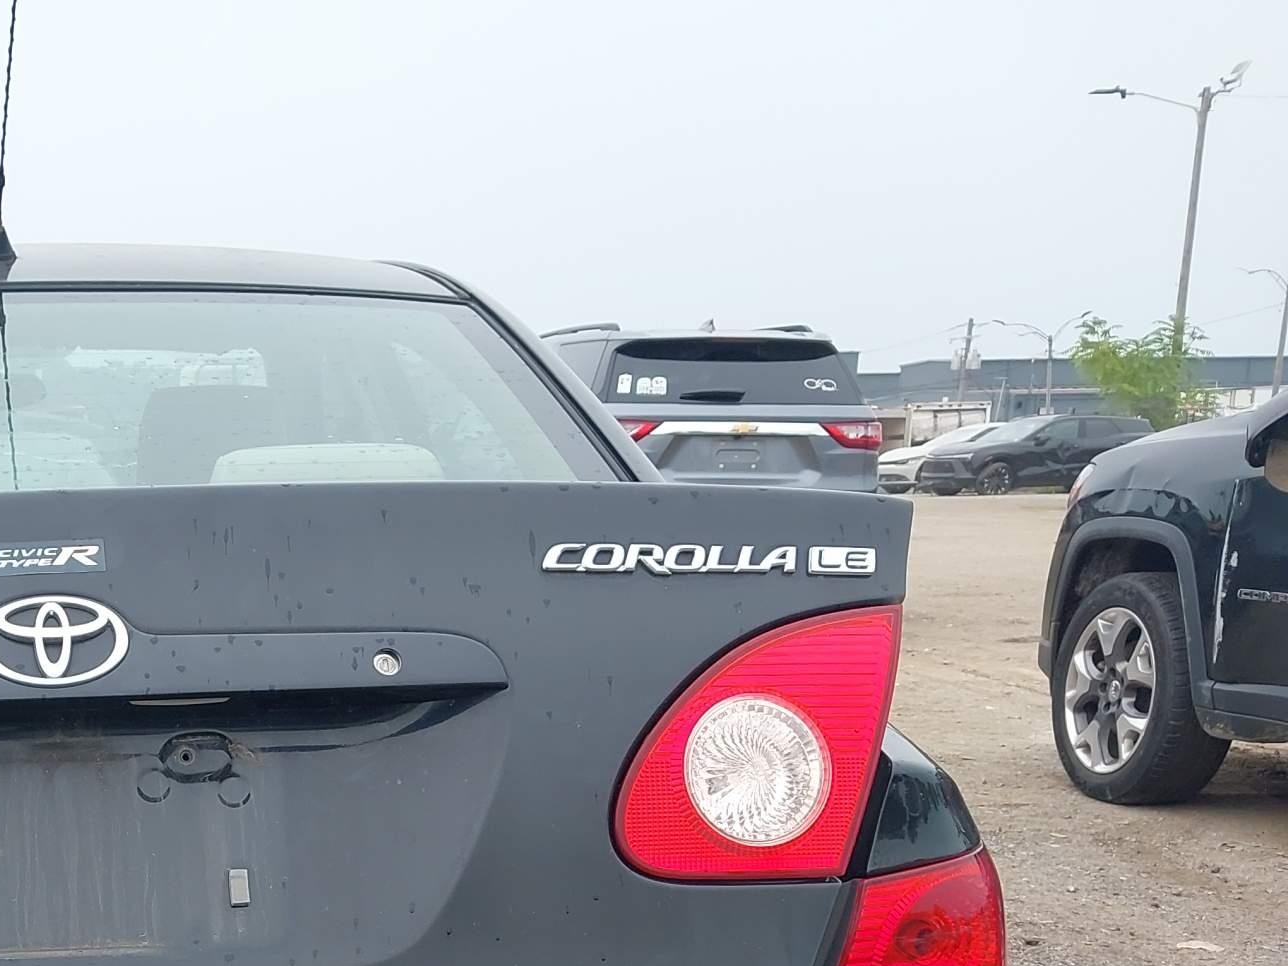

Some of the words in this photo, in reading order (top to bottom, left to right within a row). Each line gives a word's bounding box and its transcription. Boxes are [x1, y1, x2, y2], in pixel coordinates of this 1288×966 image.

[52, 545, 100, 566] R
[541, 543, 797, 575] COROLLA
[816, 548, 870, 570] LE
